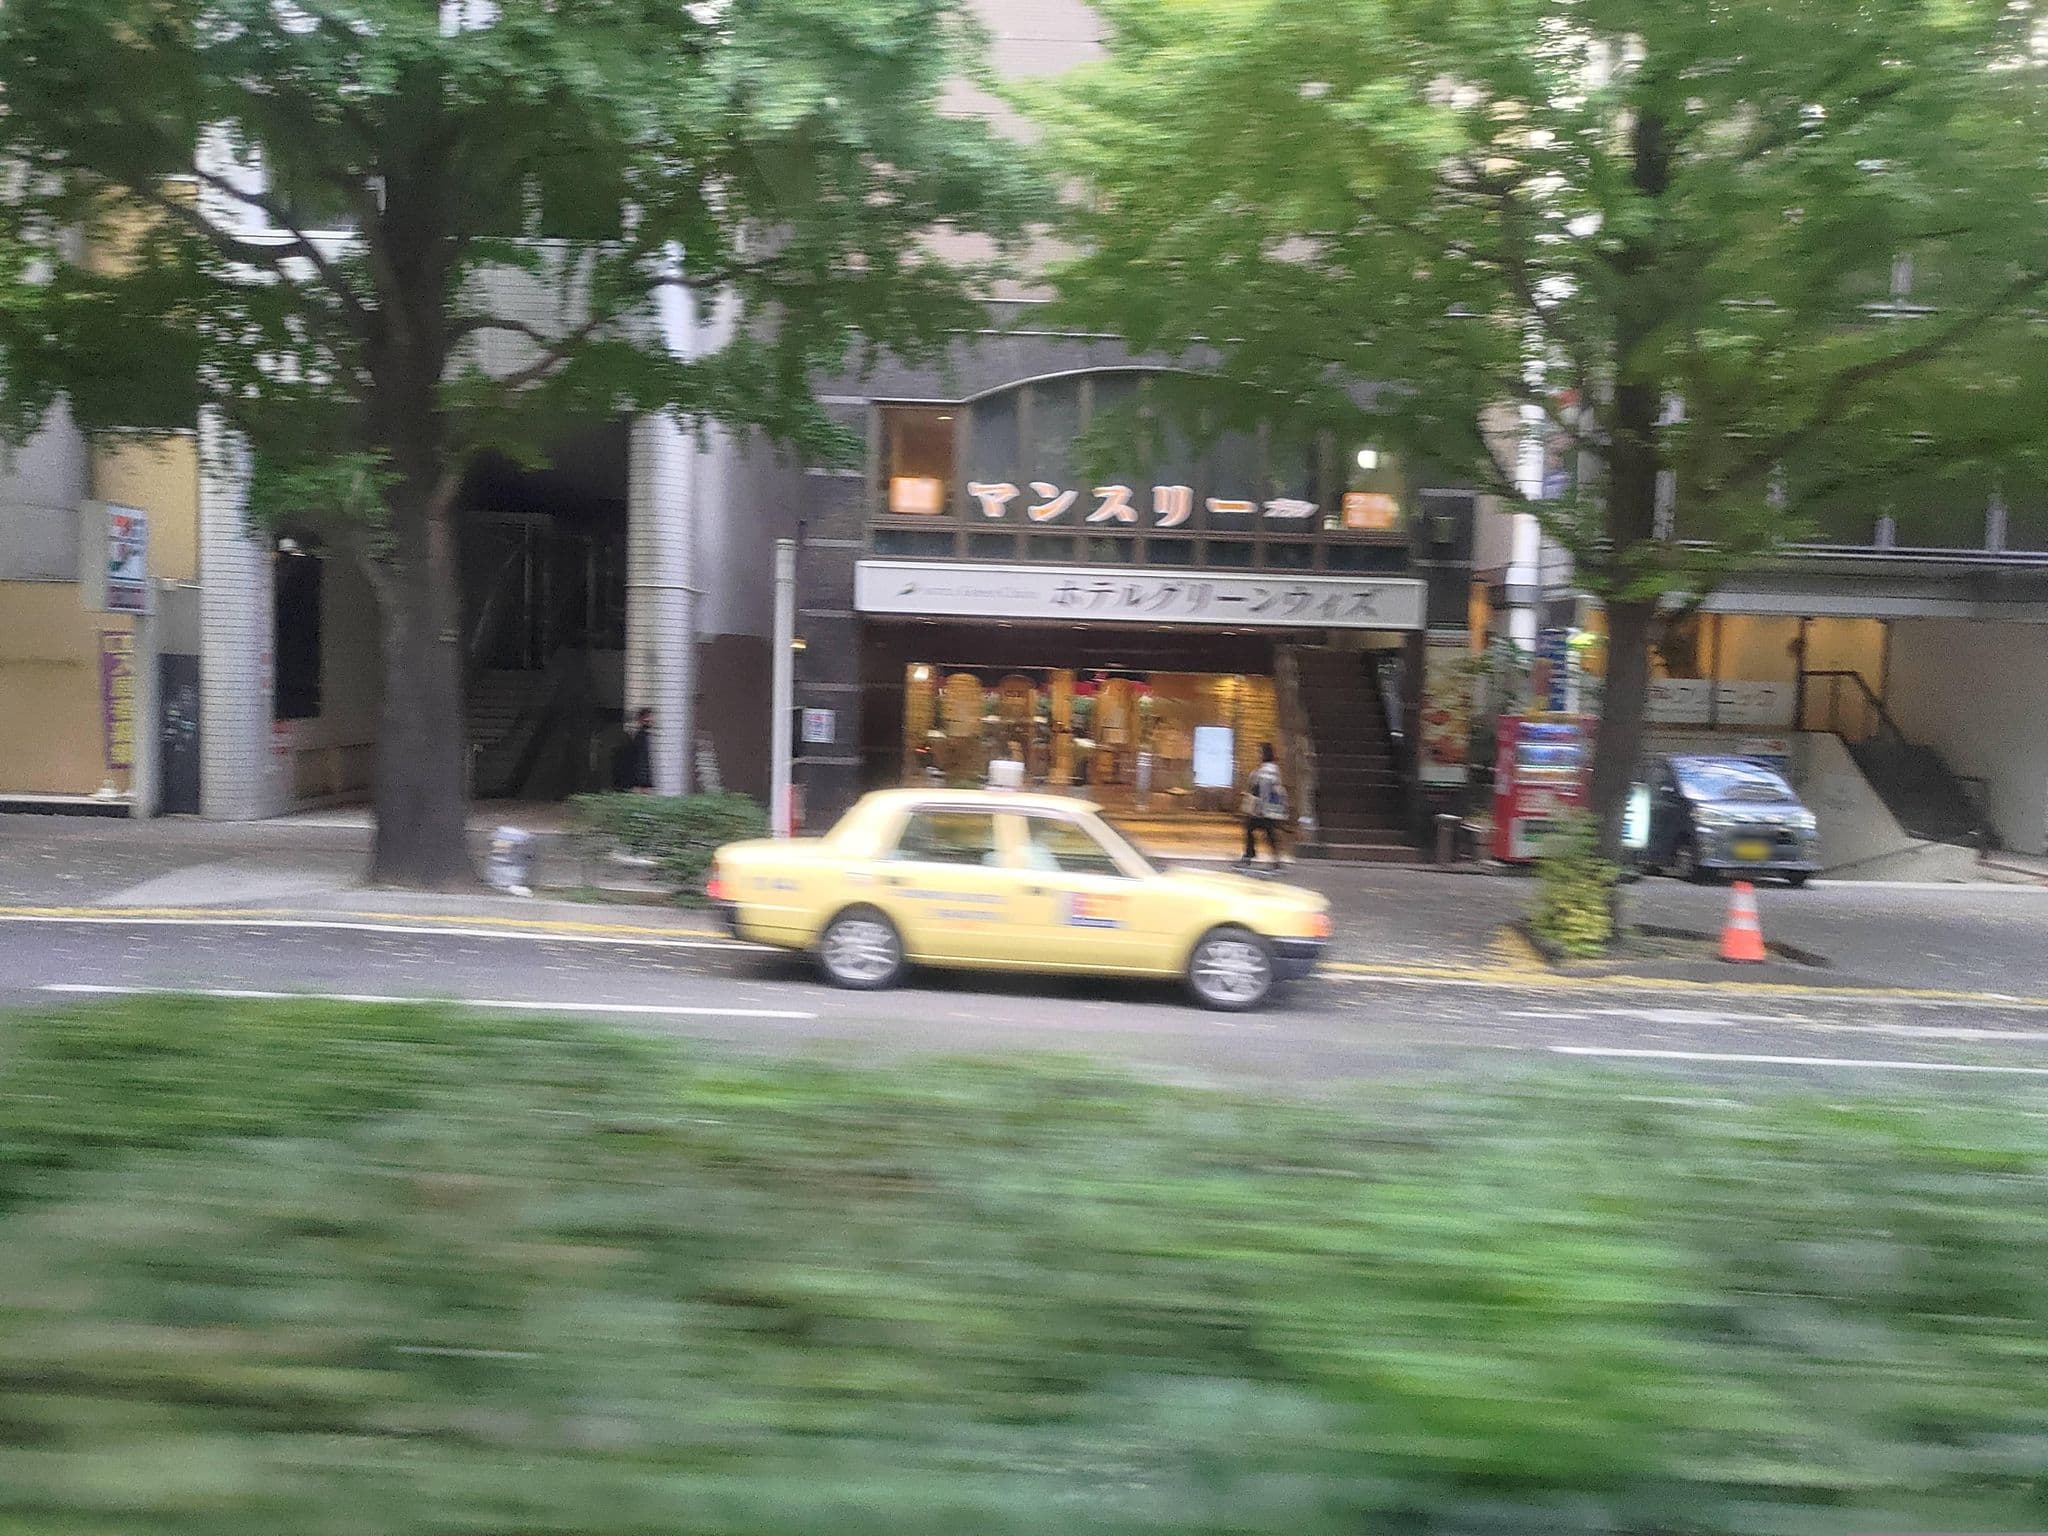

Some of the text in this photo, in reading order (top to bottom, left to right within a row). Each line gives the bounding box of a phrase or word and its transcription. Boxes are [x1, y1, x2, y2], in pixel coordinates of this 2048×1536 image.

[1051, 579, 1384, 618] ホテルグリーンウィズ
